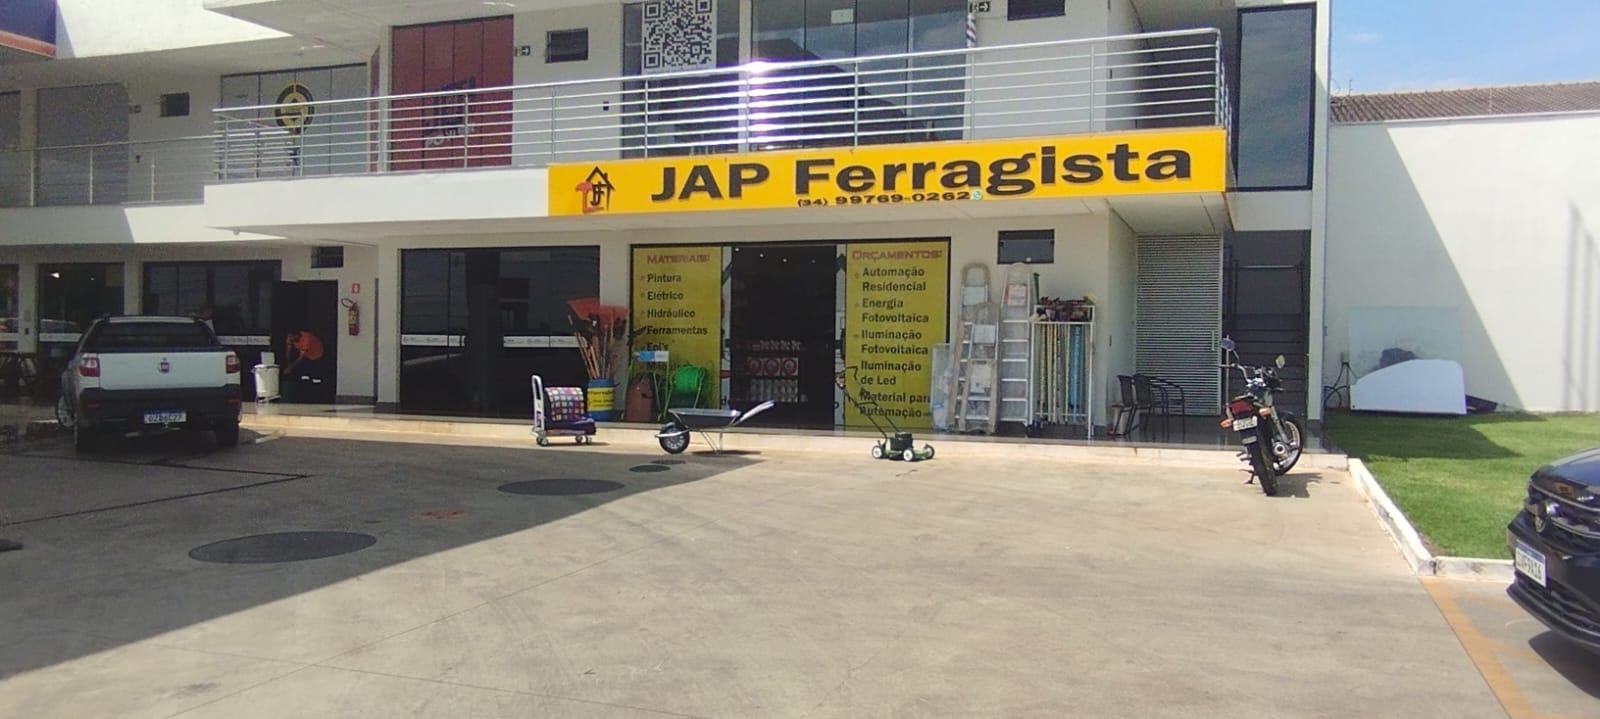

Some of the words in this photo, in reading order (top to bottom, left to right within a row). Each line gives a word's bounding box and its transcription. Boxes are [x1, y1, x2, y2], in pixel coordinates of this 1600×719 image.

[651, 163, 770, 202] JAP
[795, 144, 1192, 196] Ferragista
[796, 197, 828, 208] (34)
[834, 190, 971, 205] 99769-0262
[862, 266, 925, 279] Automação
[646, 273, 682, 284] Pintura
[862, 281, 927, 292] Residencial
[646, 290, 685, 301] Elétrico
[862, 298, 904, 310] Energia
[646, 308, 696, 319] Hidráulico
[861, 312, 930, 323] Fotovoltaica
[646, 325, 709, 336] Ferramentas
[861, 329, 923, 341] Iluminação
[861, 343, 930, 355] Fotovoltaica
[860, 360, 922, 373] Iluminação
[860, 376, 874, 385] de
[877, 376, 897, 386] Led
[860, 391, 906, 402] Material
[860, 407, 923, 419] Automação
